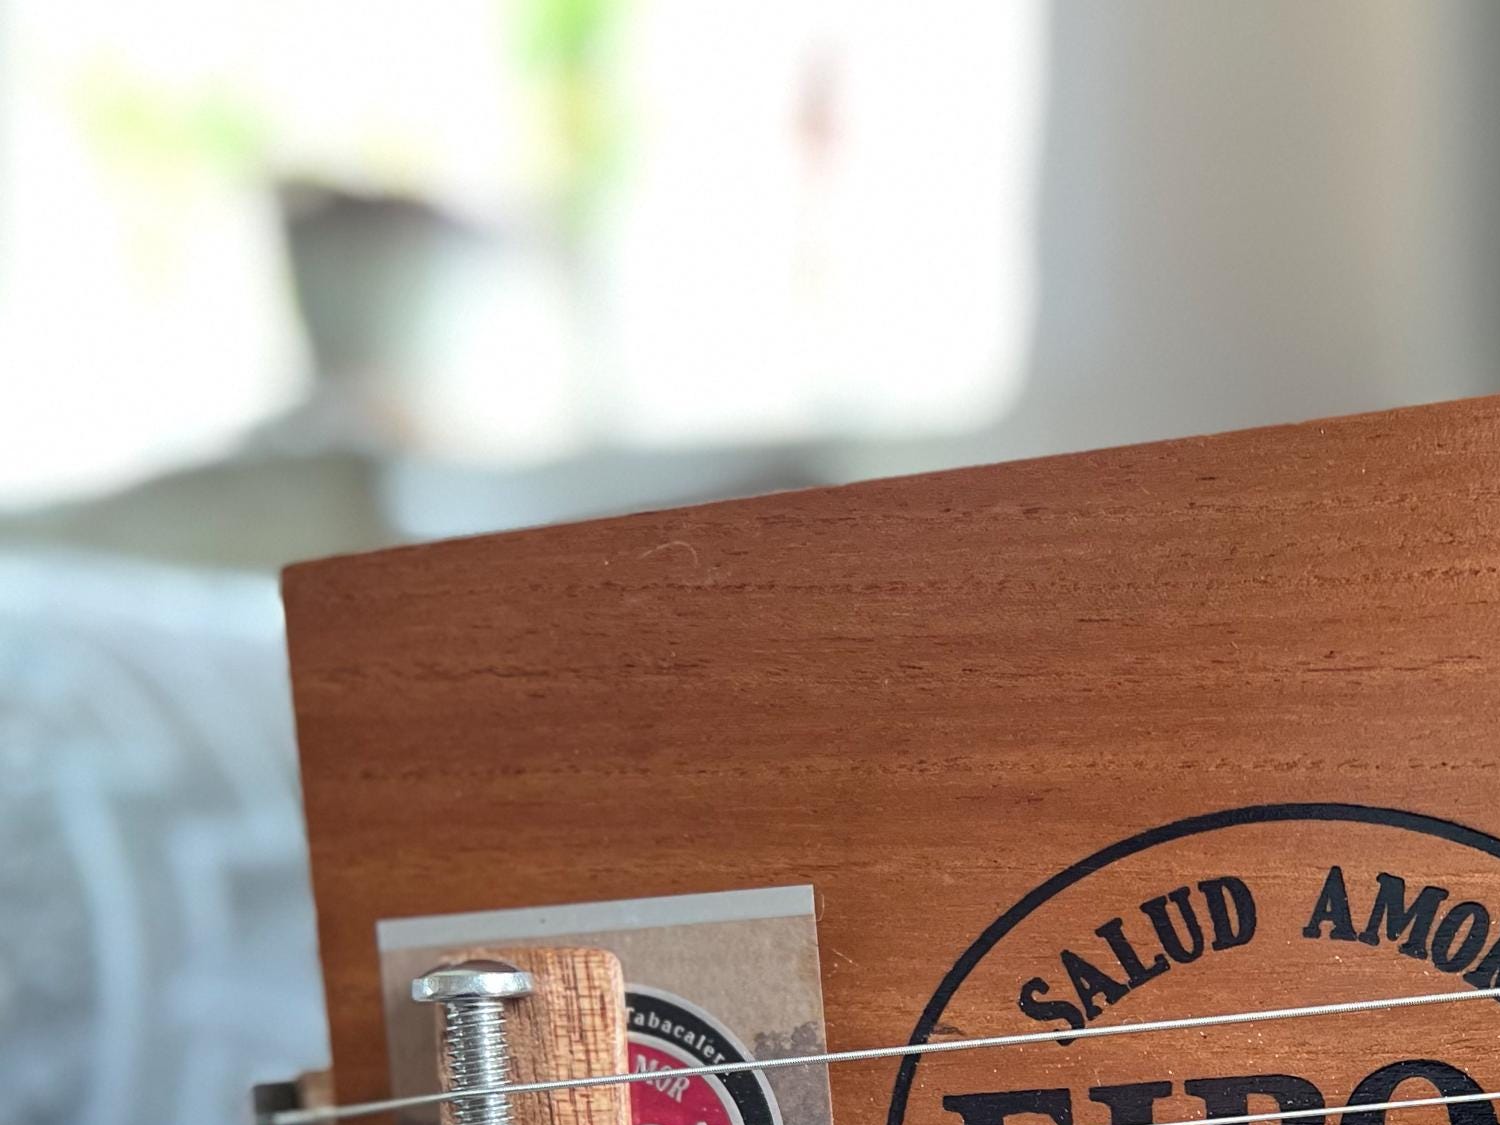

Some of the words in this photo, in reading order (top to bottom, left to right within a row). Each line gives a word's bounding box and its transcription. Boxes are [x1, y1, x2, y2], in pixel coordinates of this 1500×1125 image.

[1020, 875, 1257, 1046] SALUD
[625, 1006, 730, 1078] Tabacaler
[634, 1053, 691, 1104] MOR
